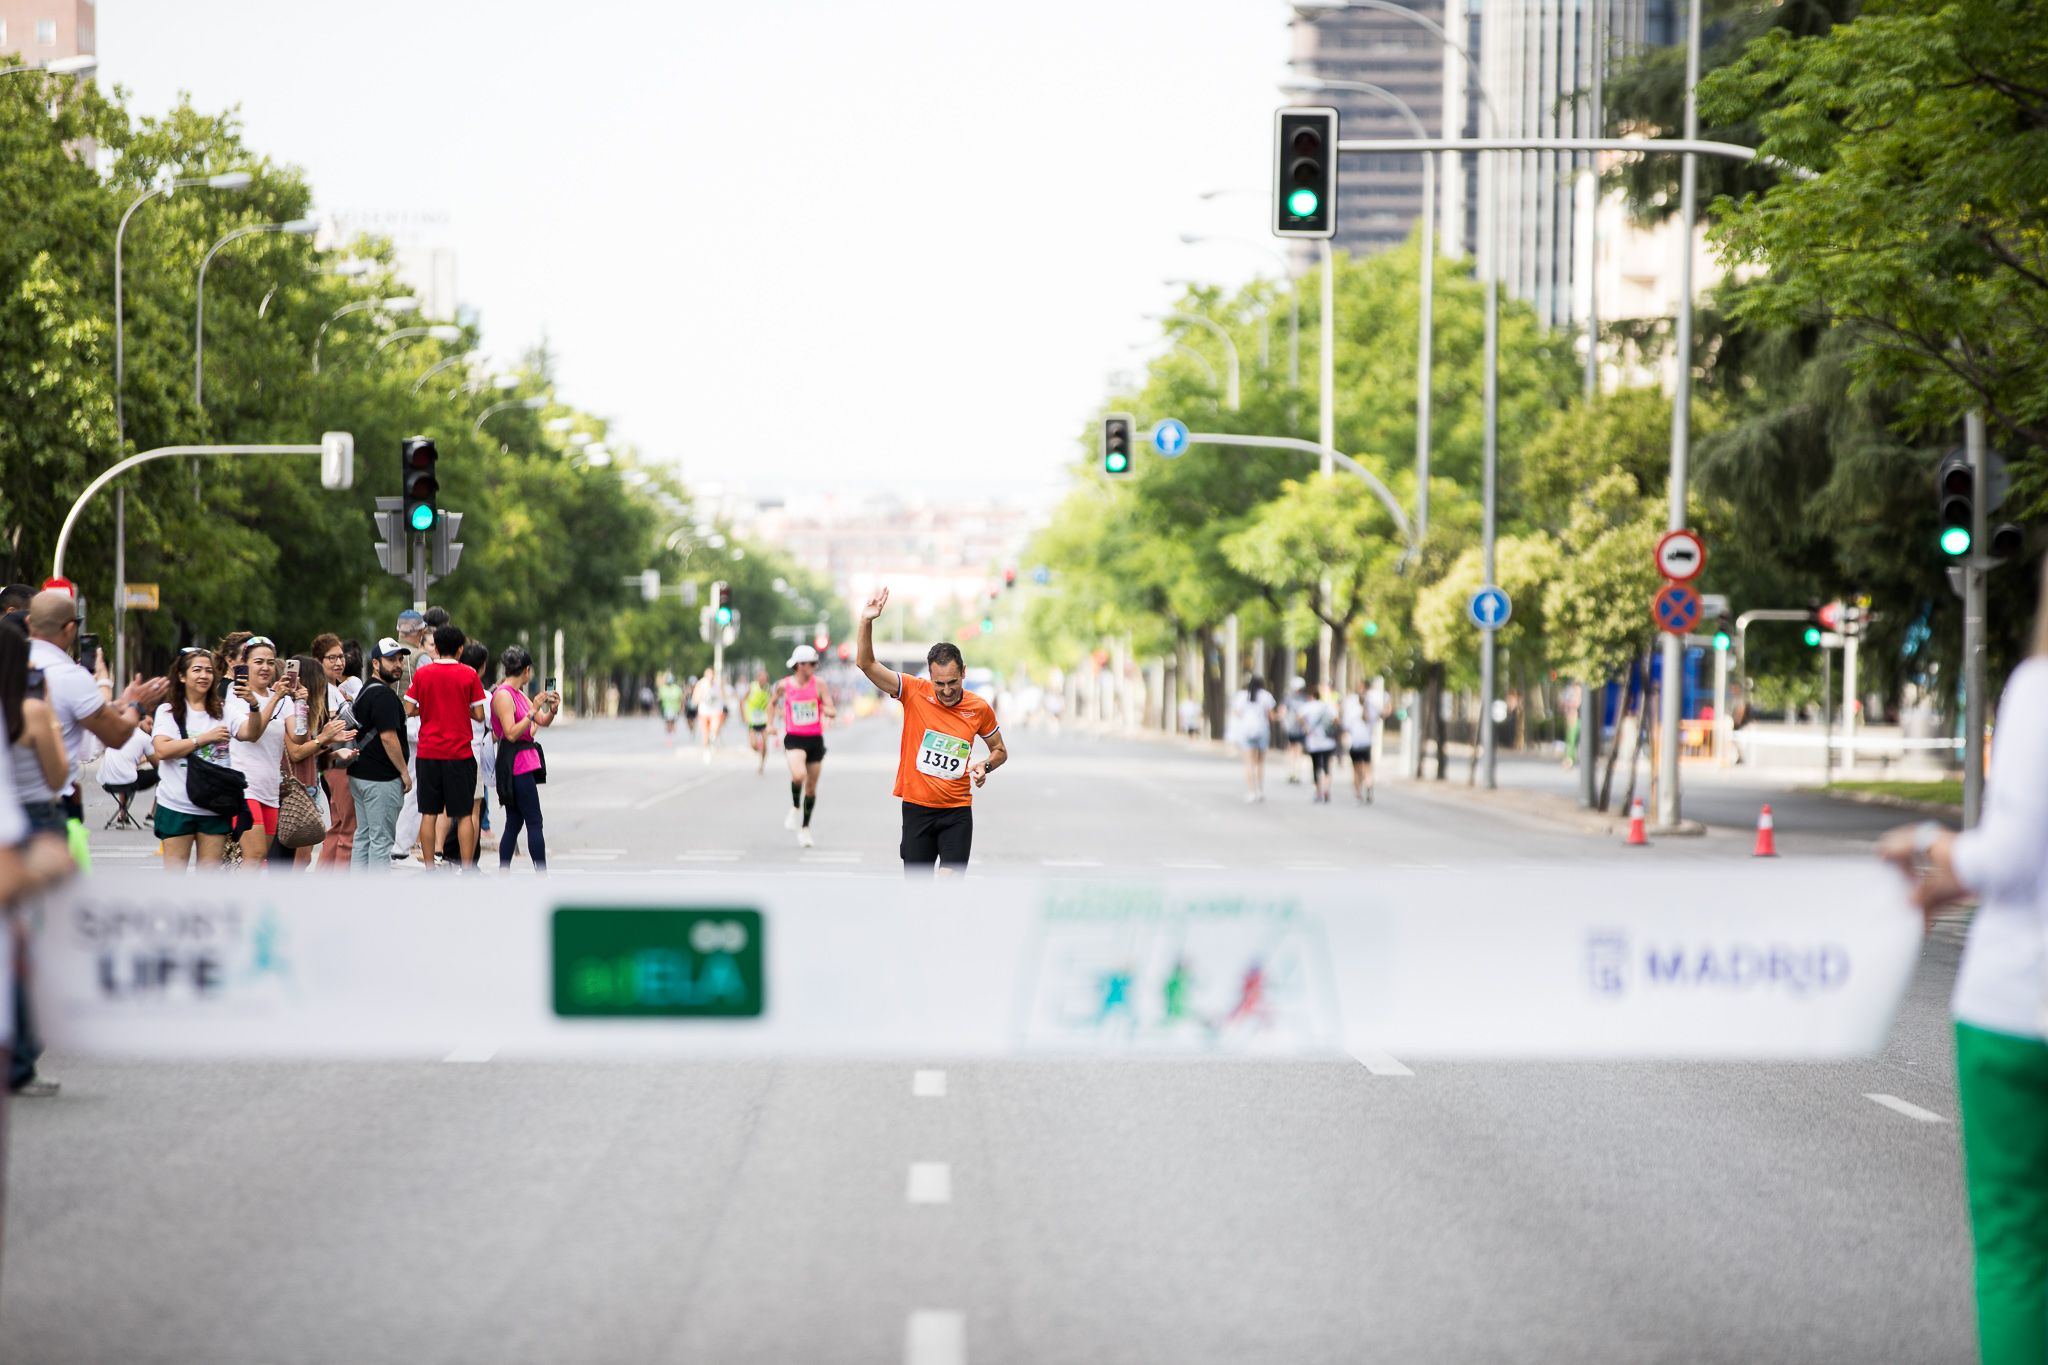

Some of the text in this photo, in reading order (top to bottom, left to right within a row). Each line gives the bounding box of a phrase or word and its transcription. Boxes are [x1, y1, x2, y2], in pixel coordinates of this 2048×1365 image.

[922, 749, 960, 772] 1319
[73, 899, 243, 946] SPORT
[97, 946, 229, 998] LIFE
[1646, 942, 1852, 995] MADRID
